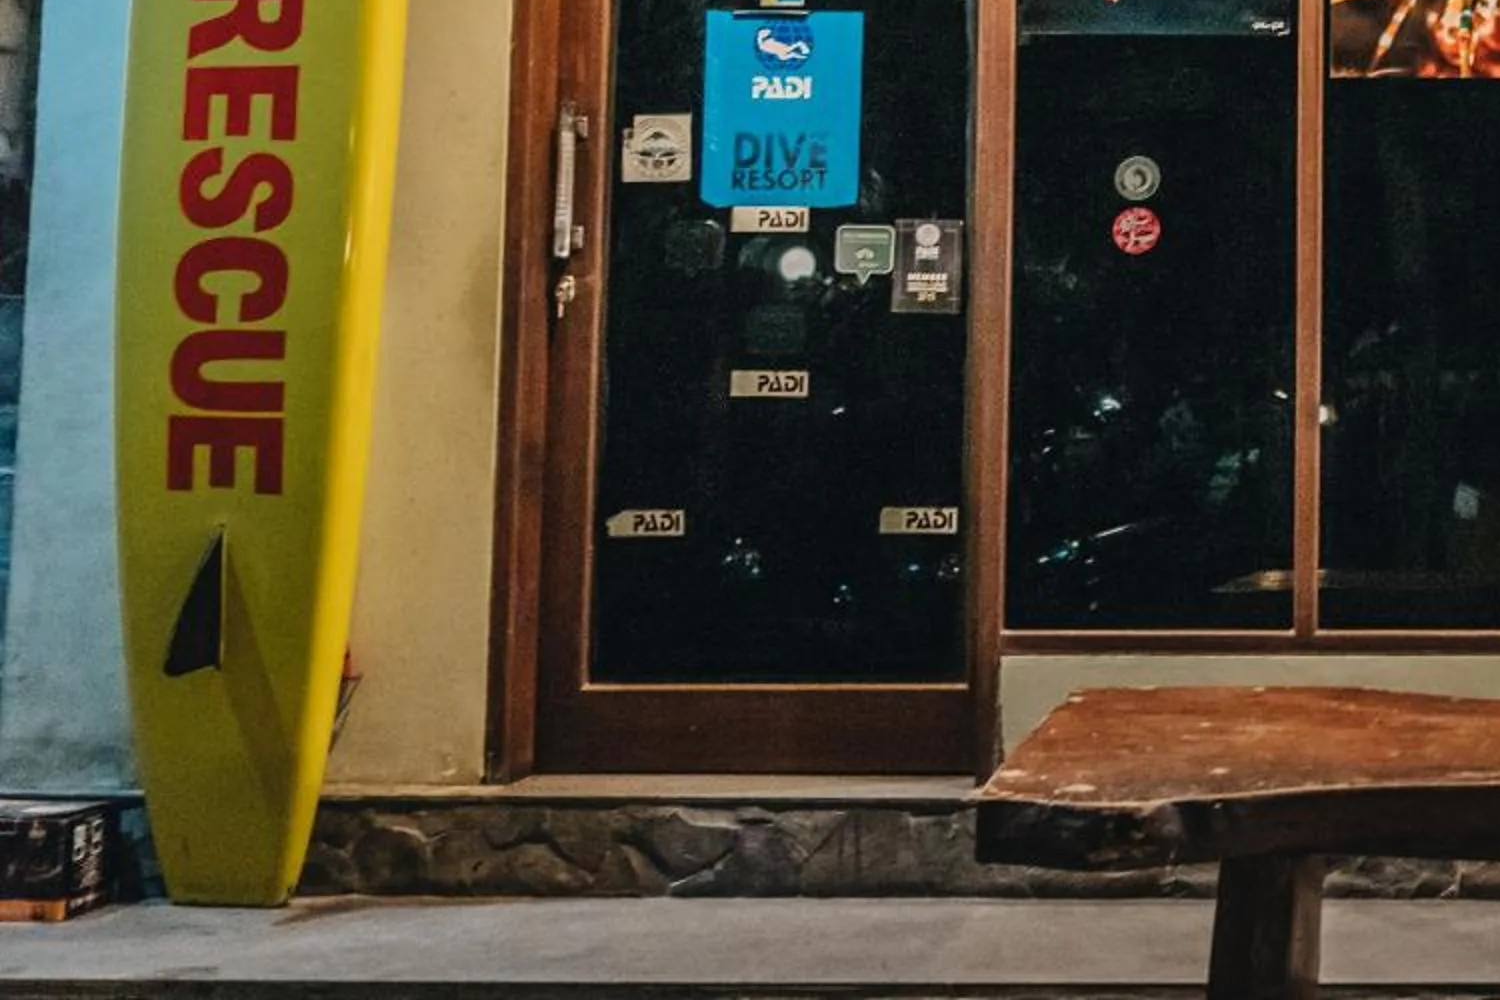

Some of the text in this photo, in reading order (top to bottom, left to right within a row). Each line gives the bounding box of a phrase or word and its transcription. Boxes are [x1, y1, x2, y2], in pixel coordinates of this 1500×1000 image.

[751, 75, 813, 100] PADI
[734, 131, 829, 169] DIVE
[731, 168, 827, 191] RESORT
[758, 210, 806, 228] PADI
[757, 374, 805, 393] PADI
[632, 513, 681, 532] PADI
[905, 511, 954, 530] PADI
